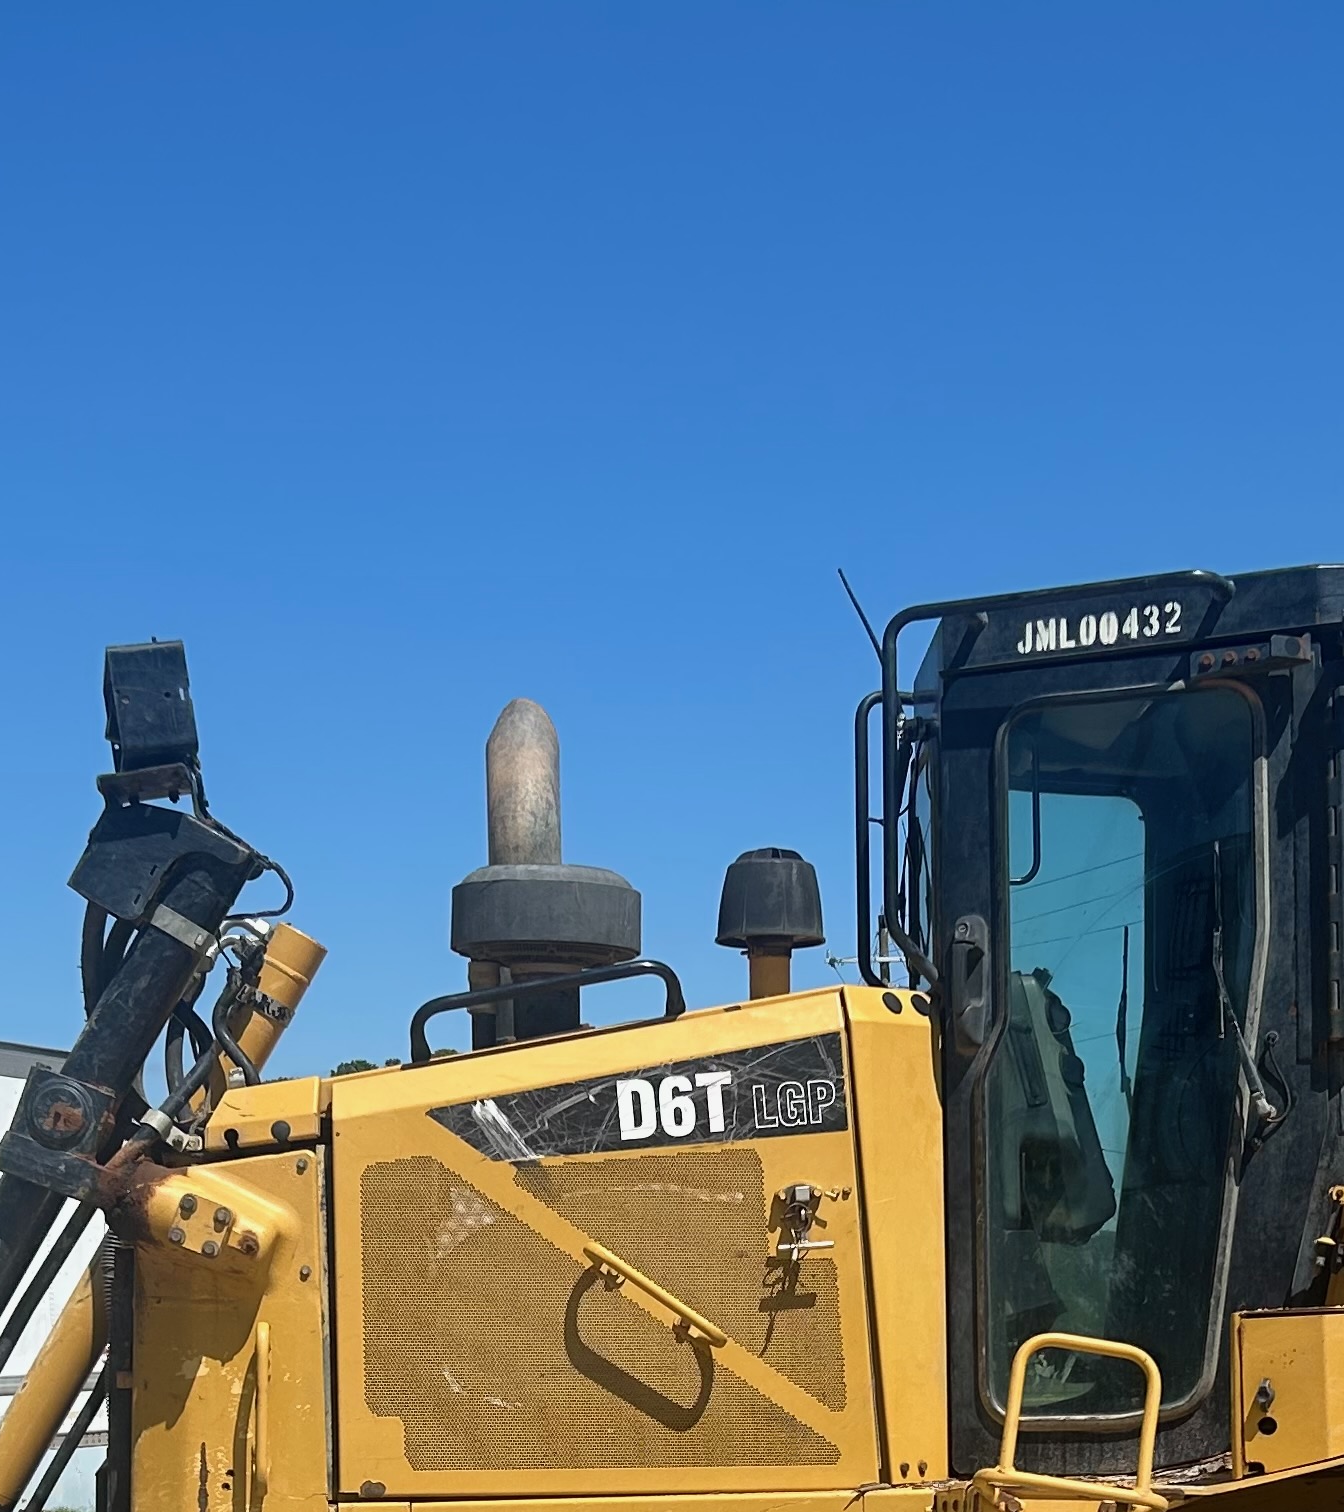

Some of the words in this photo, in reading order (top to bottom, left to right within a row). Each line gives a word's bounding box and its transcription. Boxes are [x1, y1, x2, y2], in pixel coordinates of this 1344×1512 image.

[1017, 601, 1182, 655] JML00432
[616, 1070, 732, 1141] D6T
[752, 1079, 836, 1130] LGP
